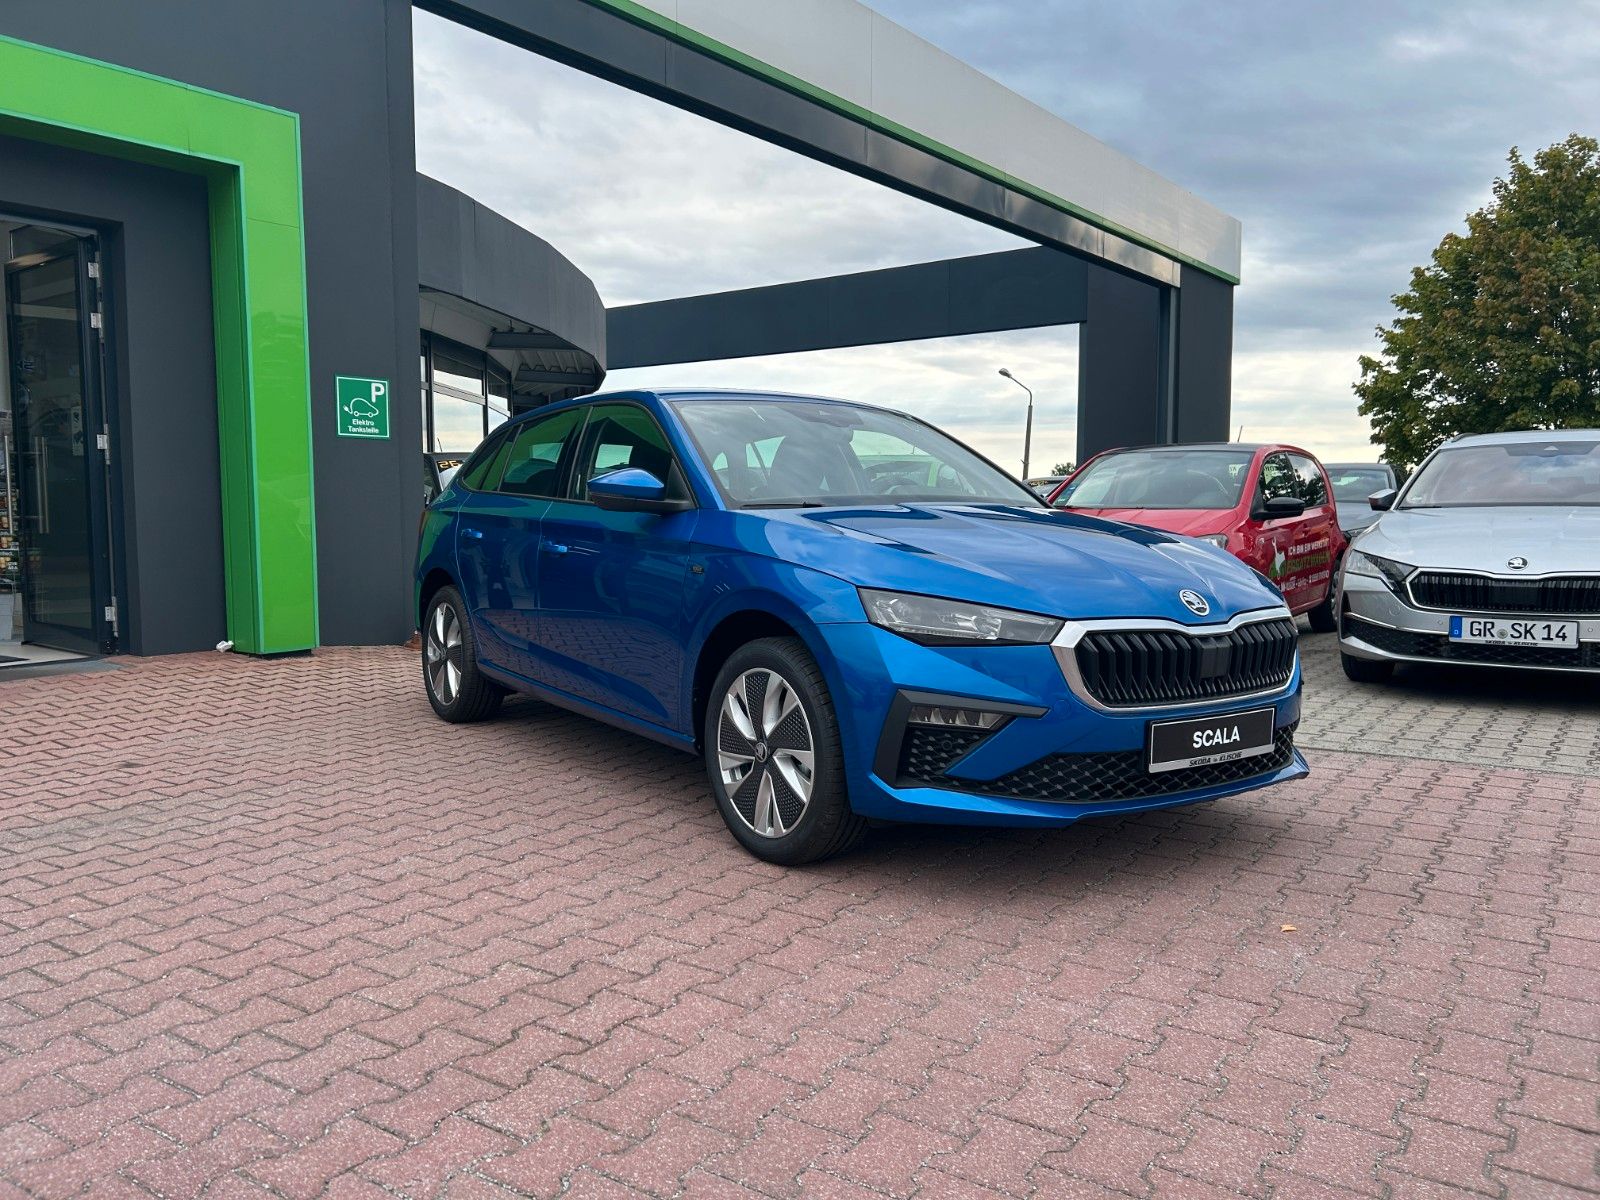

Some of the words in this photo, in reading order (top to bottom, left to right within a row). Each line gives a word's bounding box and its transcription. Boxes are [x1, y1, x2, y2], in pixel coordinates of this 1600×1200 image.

[371, 382, 385, 403] P
[347, 425, 380, 434] Tankstelle
[352, 418, 375, 426] Elektro
[1469, 620, 1496, 638] GR
[1509, 622, 1537, 640] SK
[1541, 624, 1567, 642] 14
[1192, 725, 1240, 749] SCALA
